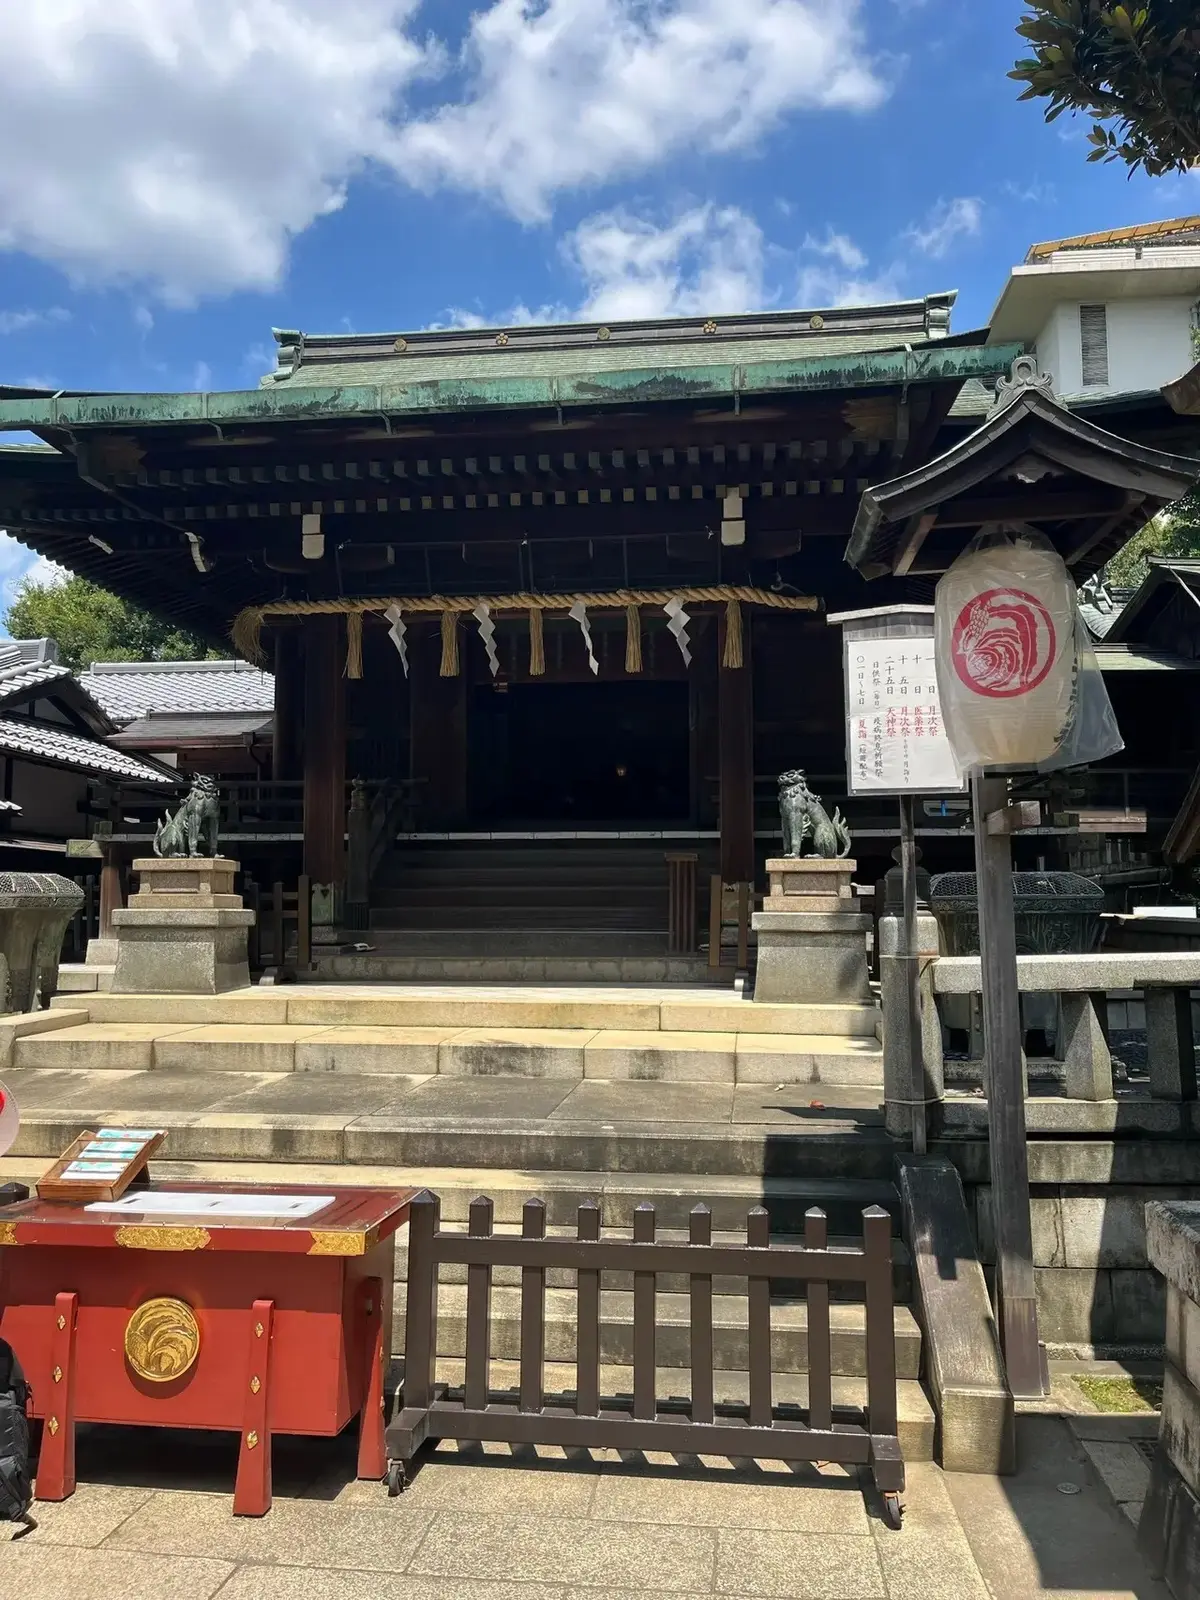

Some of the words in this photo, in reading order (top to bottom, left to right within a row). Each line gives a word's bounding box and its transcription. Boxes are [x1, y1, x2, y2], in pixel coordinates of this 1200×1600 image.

[884, 655, 896, 695] 二十五日
[898, 654, 909, 695] 十五日
[912, 654, 922, 694] 十日
[885, 706, 897, 738] 天神祭
[899, 705, 911, 737] 月次祭
[914, 705, 925, 737] 医薬祭
[927, 705, 938, 737] 月次祭
